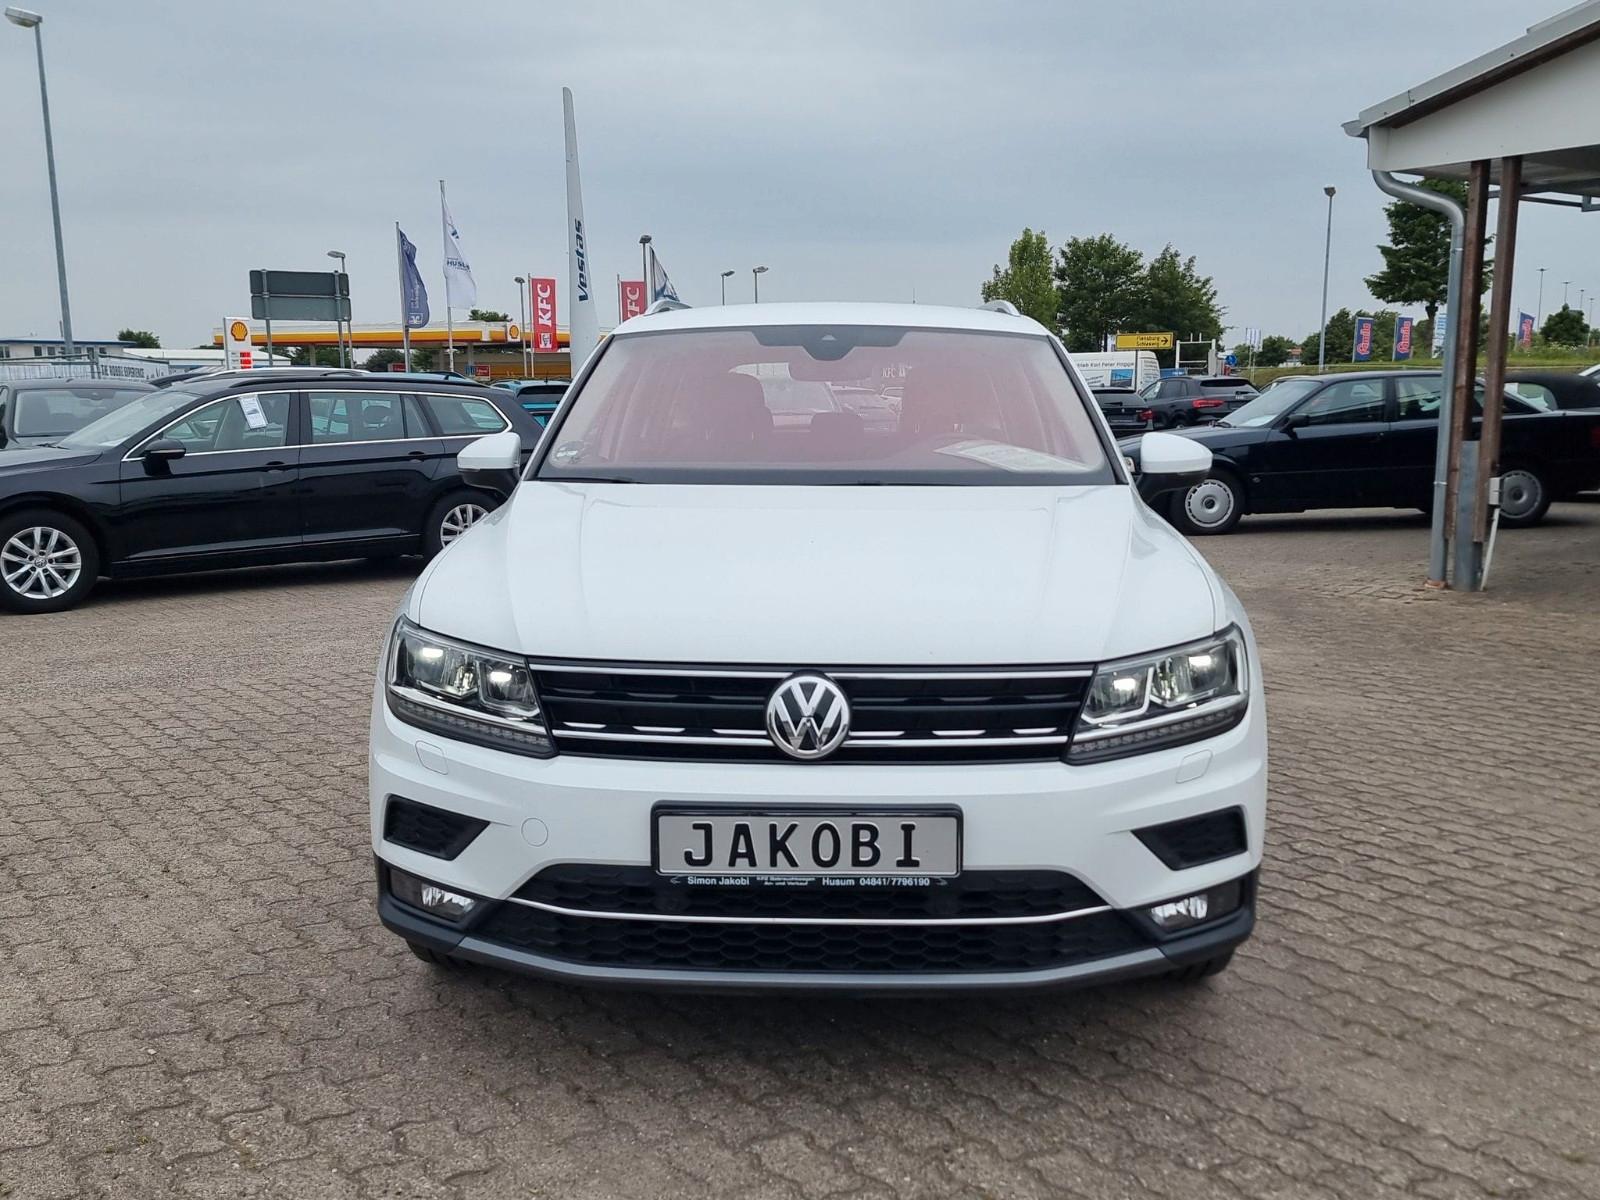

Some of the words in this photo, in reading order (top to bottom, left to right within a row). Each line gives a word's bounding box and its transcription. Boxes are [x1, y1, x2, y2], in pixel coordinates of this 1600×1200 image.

[575, 218, 589, 302] Vestas
[537, 283, 552, 327] KFC
[683, 822, 920, 868] JAKOBI
[687, 876, 717, 885] Simon
[719, 876, 750, 886] Jakobi
[822, 877, 855, 886] Husum
[859, 877, 930, 886] 04841/7796190
